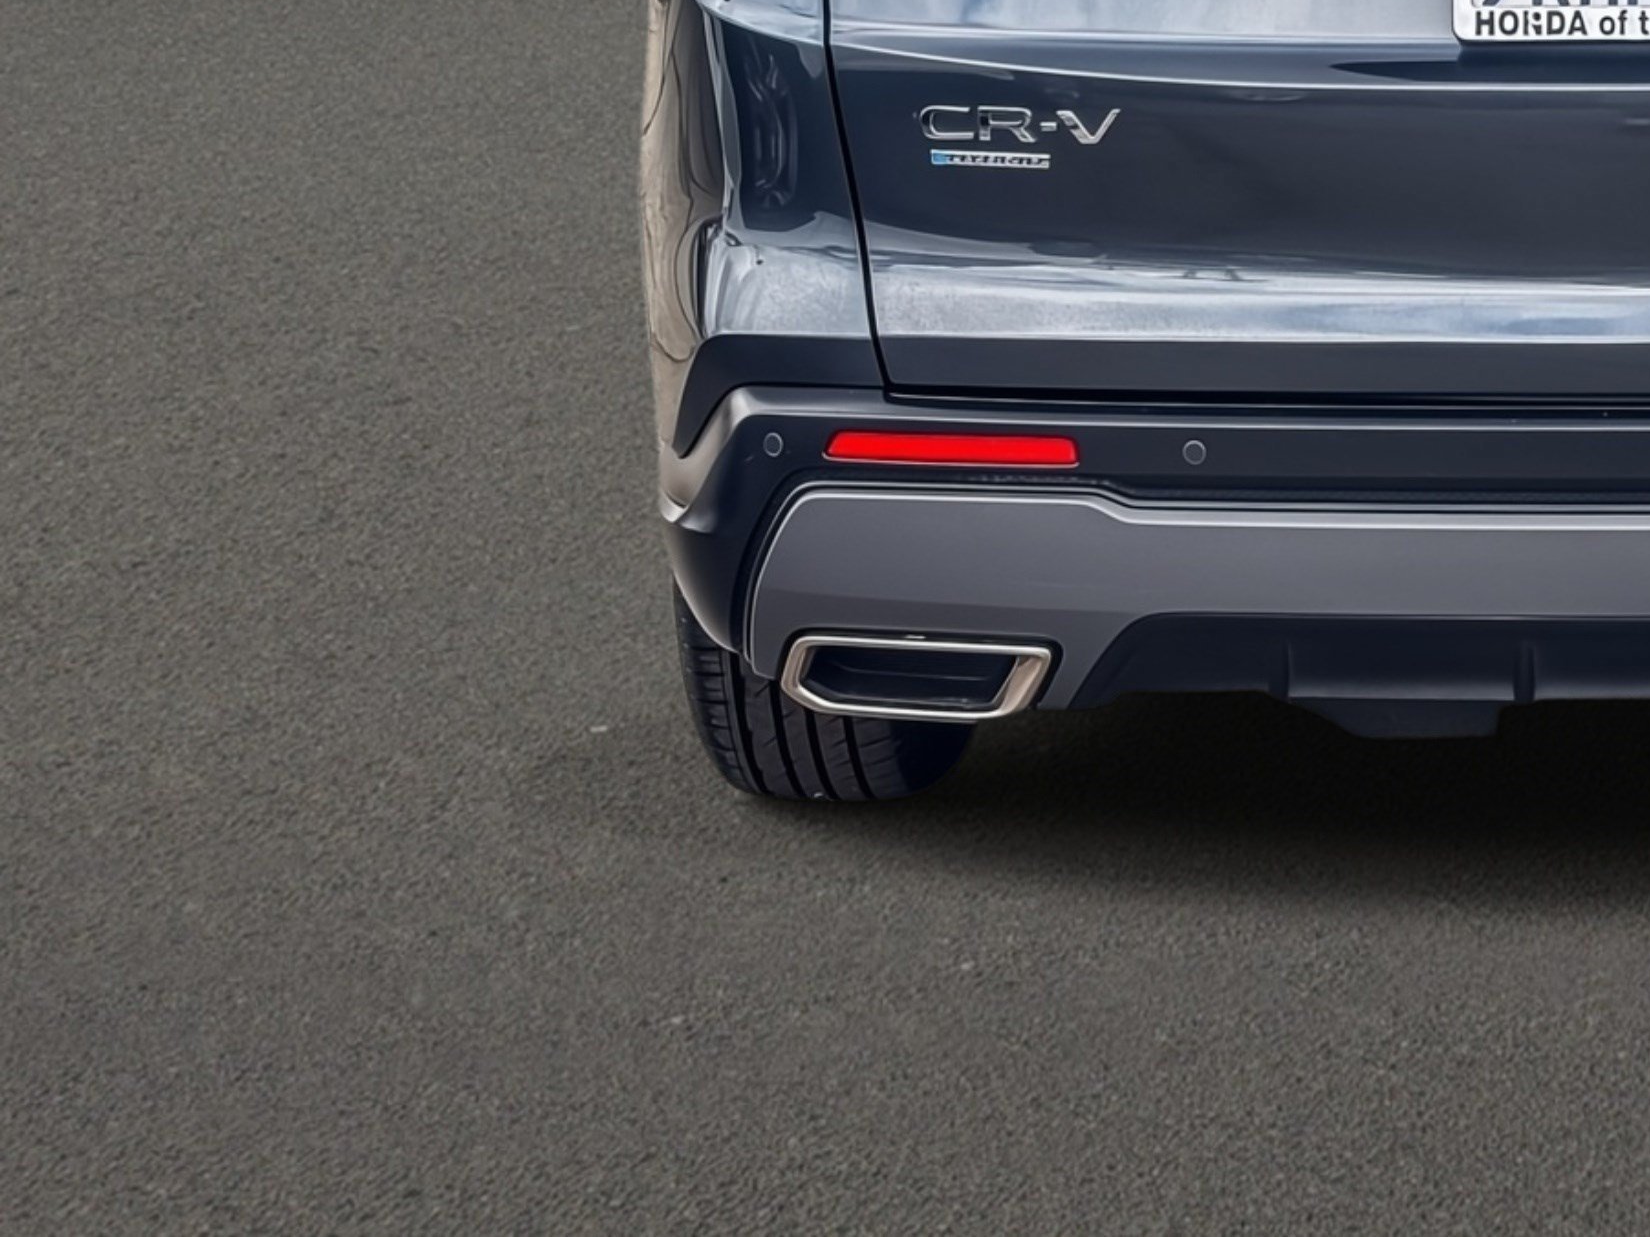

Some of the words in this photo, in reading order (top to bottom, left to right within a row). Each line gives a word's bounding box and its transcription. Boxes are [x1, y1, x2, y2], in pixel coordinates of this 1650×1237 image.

[1474, 9, 1588, 36] HONDA
[1599, 9, 1628, 36] of
[919, 104, 1121, 144] CR-V
